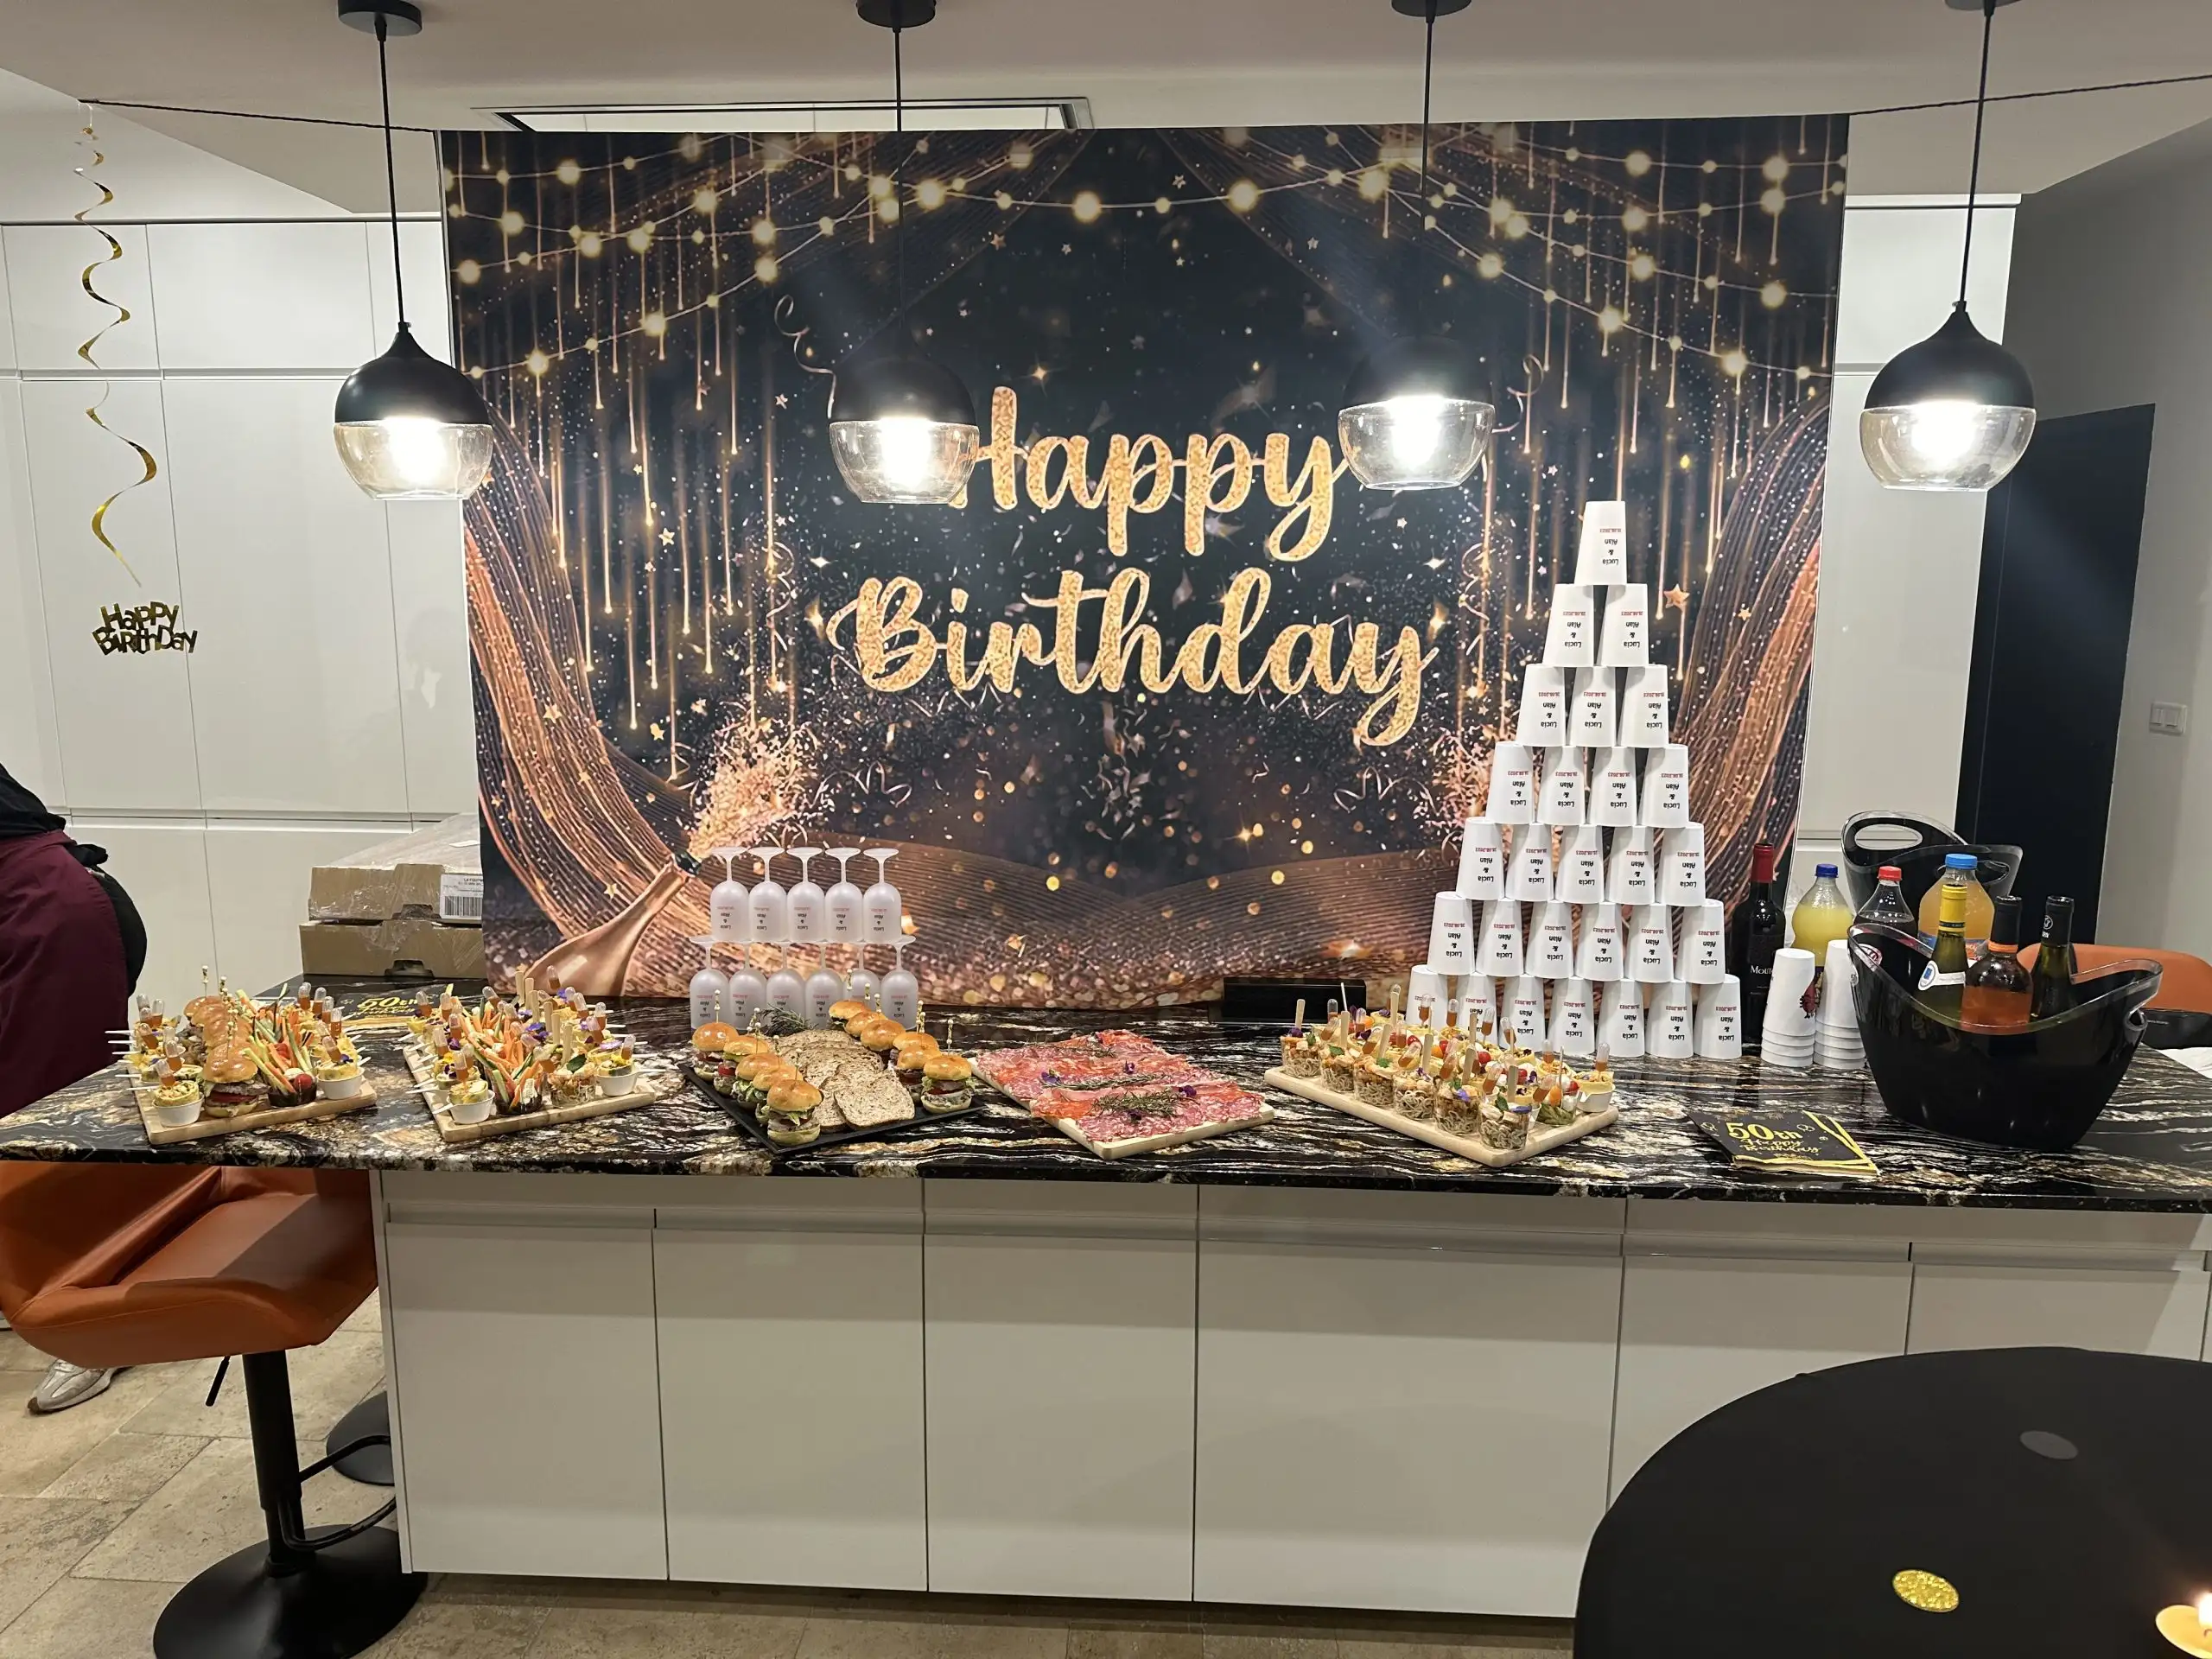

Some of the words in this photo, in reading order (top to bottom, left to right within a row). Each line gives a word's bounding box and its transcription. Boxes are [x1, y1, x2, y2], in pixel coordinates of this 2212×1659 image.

[826, 565, 1439, 747] Birthday
[1586, 702, 1602, 710] Alan
[1648, 702, 1662, 710] Alan
[1665, 783, 1680, 791] Alan
[1529, 858, 1544, 867] Alan
[1681, 861, 1696, 870] Alan
[1447, 931, 1462, 940] Alan
[1548, 935, 1563, 944] Alan
[1644, 938, 1660, 947] Alan
[1702, 940, 1717, 949] Alan
[1518, 1009, 1534, 1018] Alan
[1726, 1122, 1803, 1141] 50th
